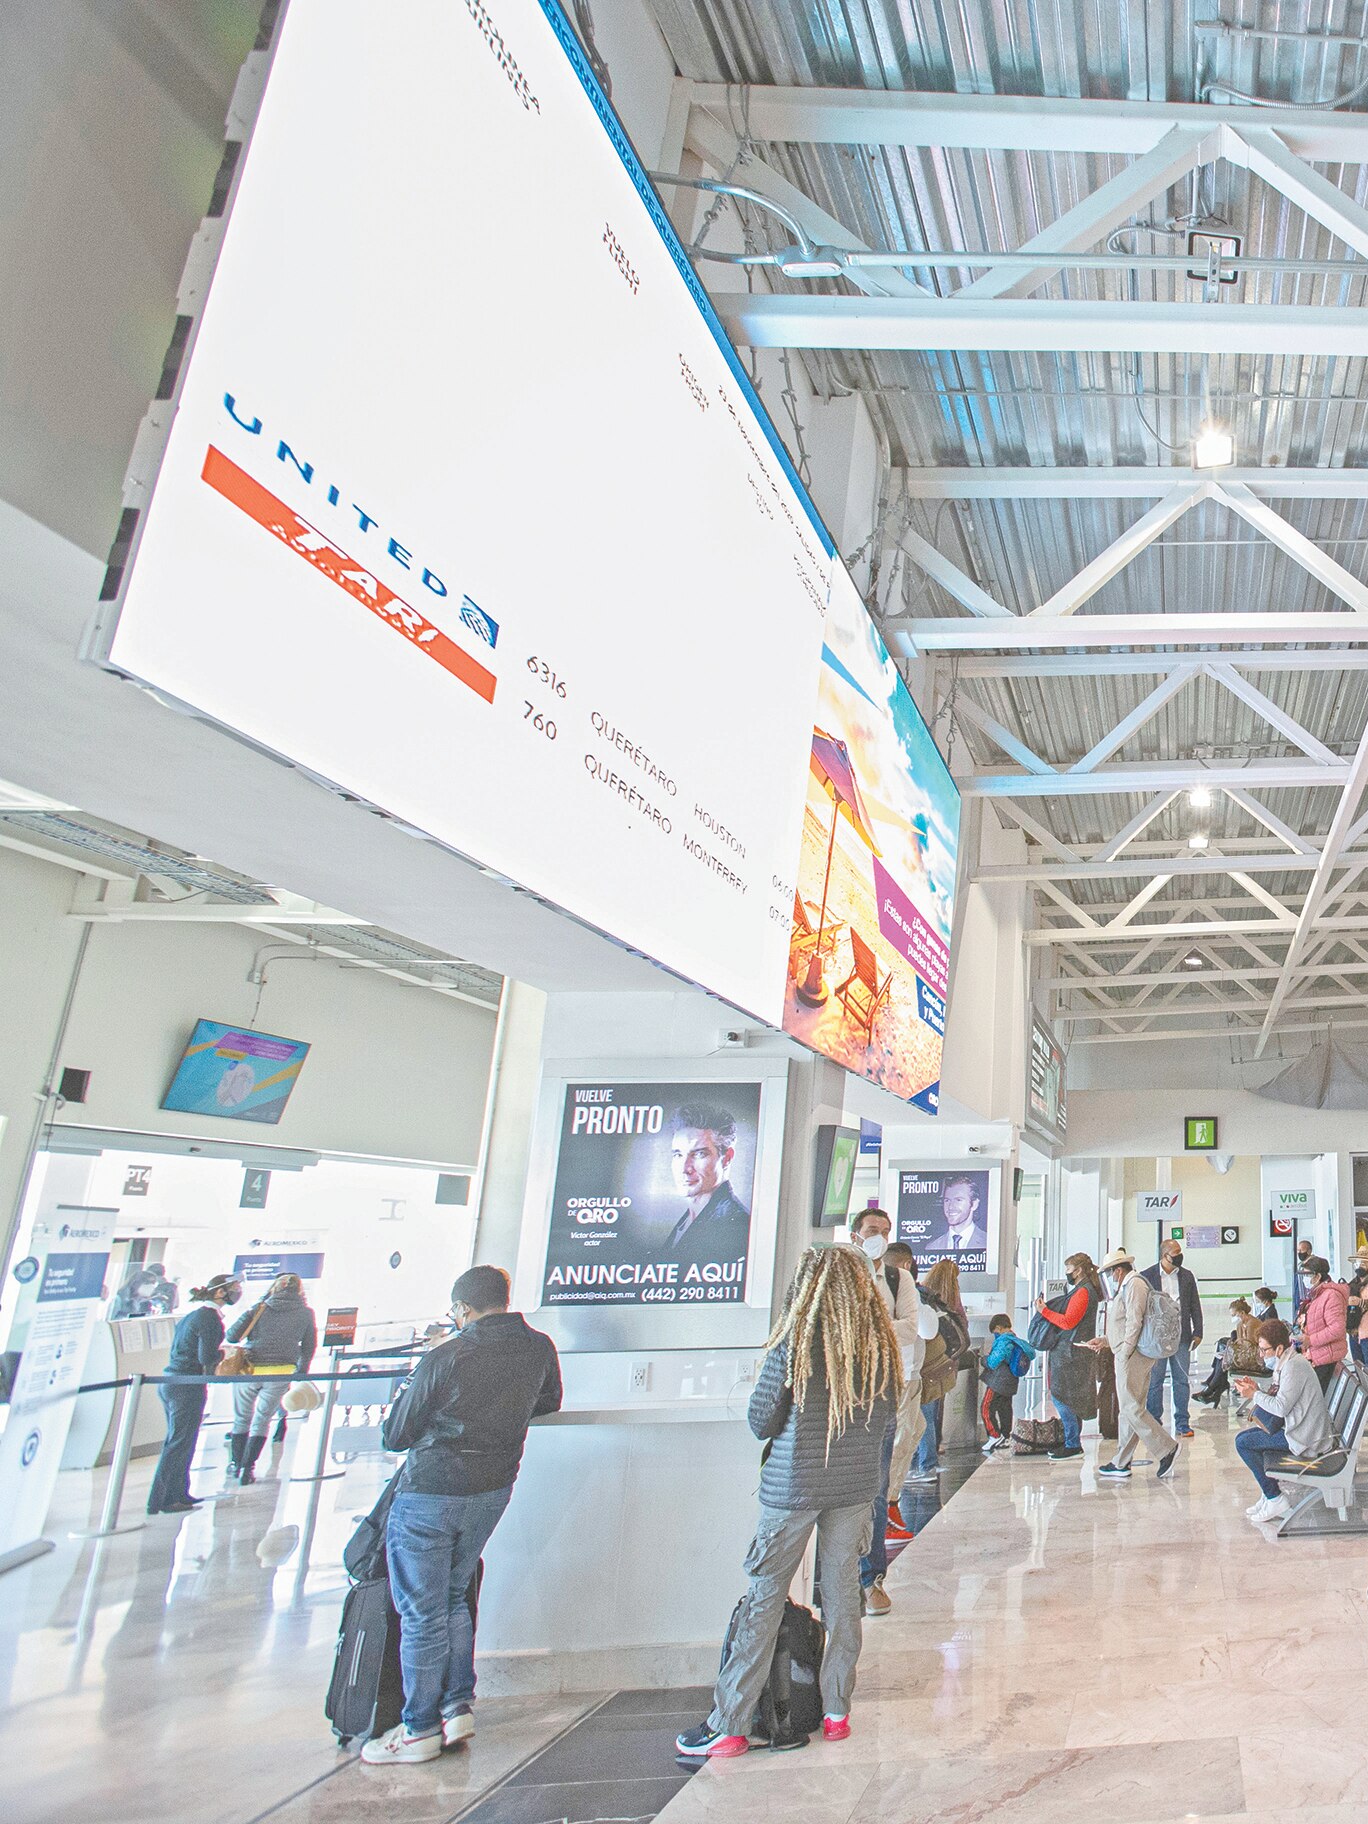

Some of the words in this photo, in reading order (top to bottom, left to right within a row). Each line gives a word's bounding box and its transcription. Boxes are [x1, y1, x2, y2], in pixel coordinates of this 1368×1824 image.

[223, 392, 447, 597] UNITED
[526, 655, 568, 699] 6316
[522, 700, 557, 741] 760
[590, 711, 678, 797] QUERÉTARO
[694, 803, 747, 859] HOUSTON
[584, 753, 673, 835] QUERÉTARO
[683, 833, 748, 895] MONTERREY
[575, 1089, 613, 1103] VUELVE
[571, 1105, 664, 1135] PRONTO
[250, 1173, 263, 1192] 4
[902, 1181, 939, 1194] PRONTO
[566, 1197, 632, 1208] ORGULLO
[1144, 1196, 1170, 1208] TAR
[1280, 1193, 1307, 1203] viva
[567, 1209, 577, 1217] DE
[576, 1207, 619, 1224] QRO
[959, 1251, 987, 1264] AQUÍ
[547, 1264, 679, 1285] ANUNCIATE
[684, 1256, 746, 1283] AQUÍ
[641, 1287, 676, 1302] (442)
[679, 1287, 703, 1300] 290
[707, 1286, 738, 1299] 8411
[1049, 1282, 1064, 1292] TAR
